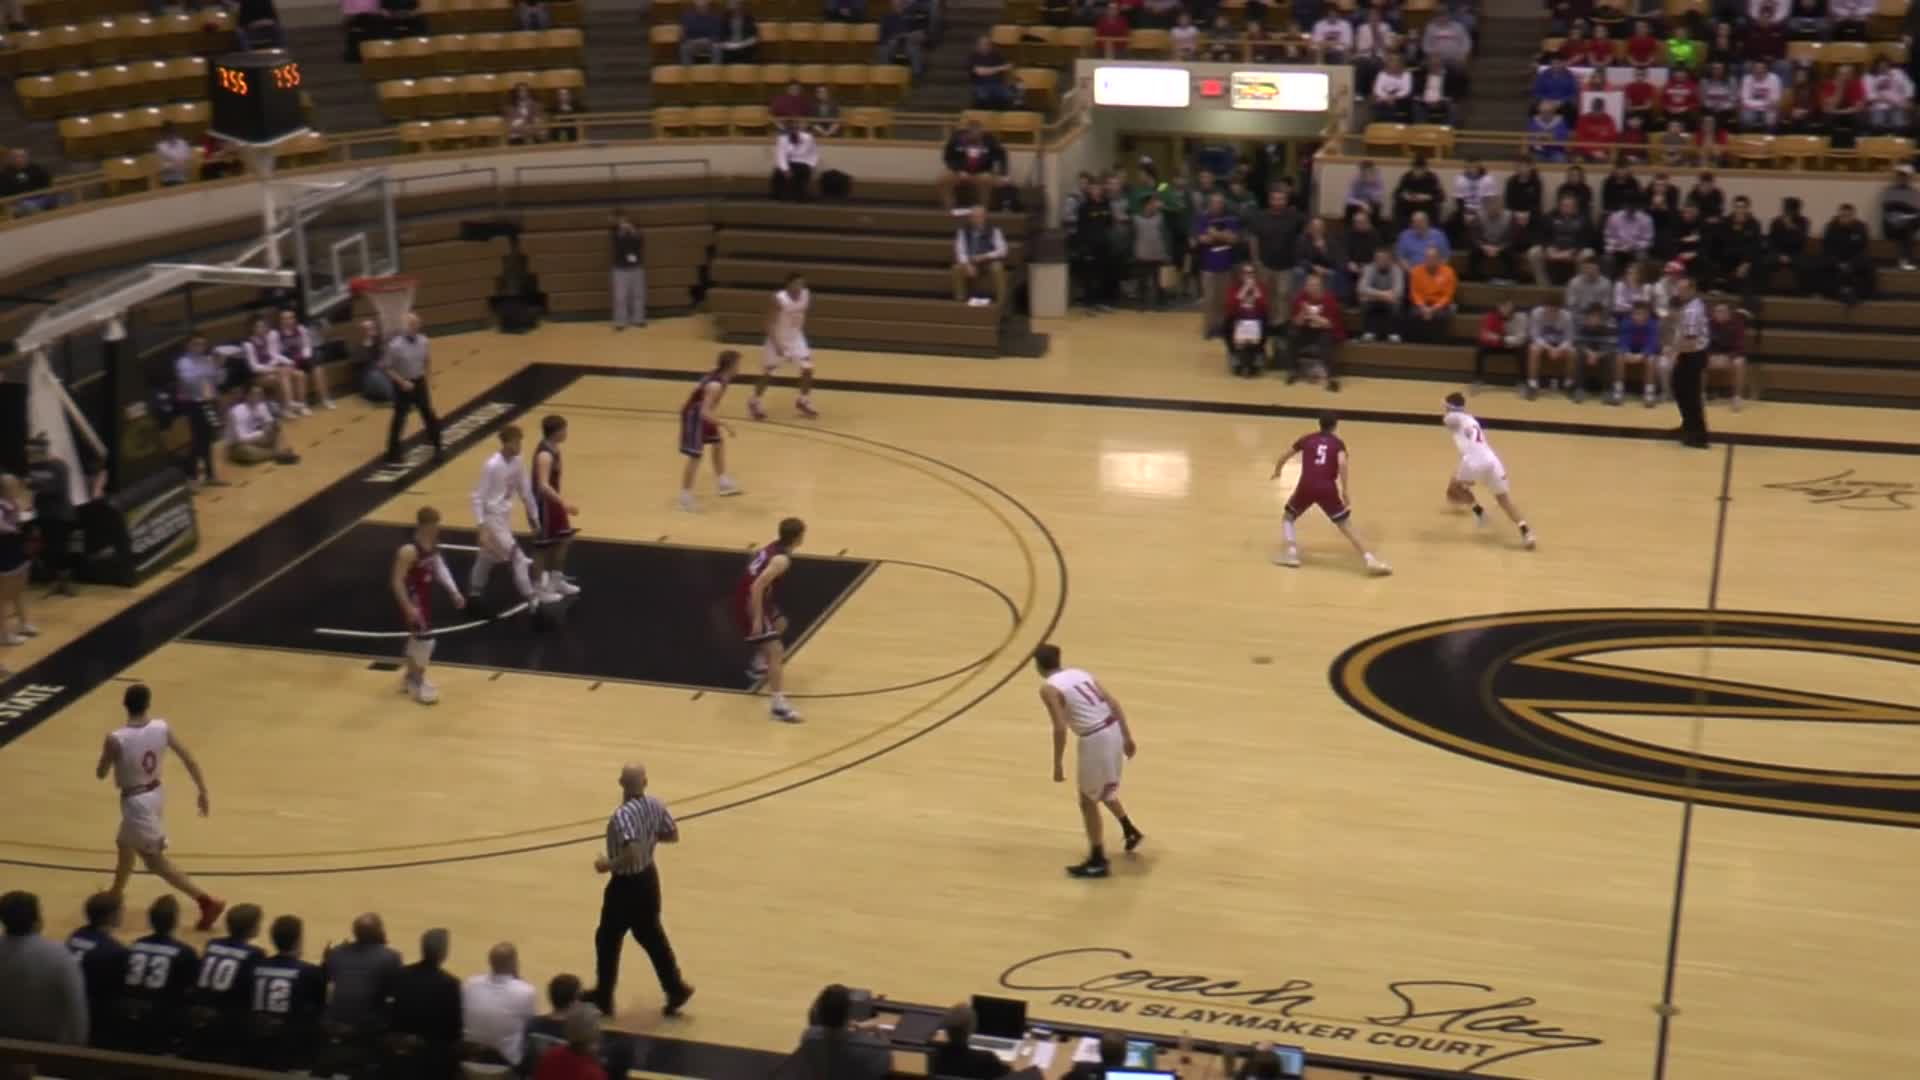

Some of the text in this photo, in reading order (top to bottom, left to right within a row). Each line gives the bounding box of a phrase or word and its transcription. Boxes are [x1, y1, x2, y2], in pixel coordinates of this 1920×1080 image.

[1315, 445, 1328, 464] 5
[0, 683, 66, 719] STATE
[142, 750, 157, 774] 0
[125, 953, 171, 988] 33
[197, 955, 239, 991] 10
[999, 947, 1315, 1016] Coach
[1050, 992, 1497, 1058] RON SLAYMAKER COURT
